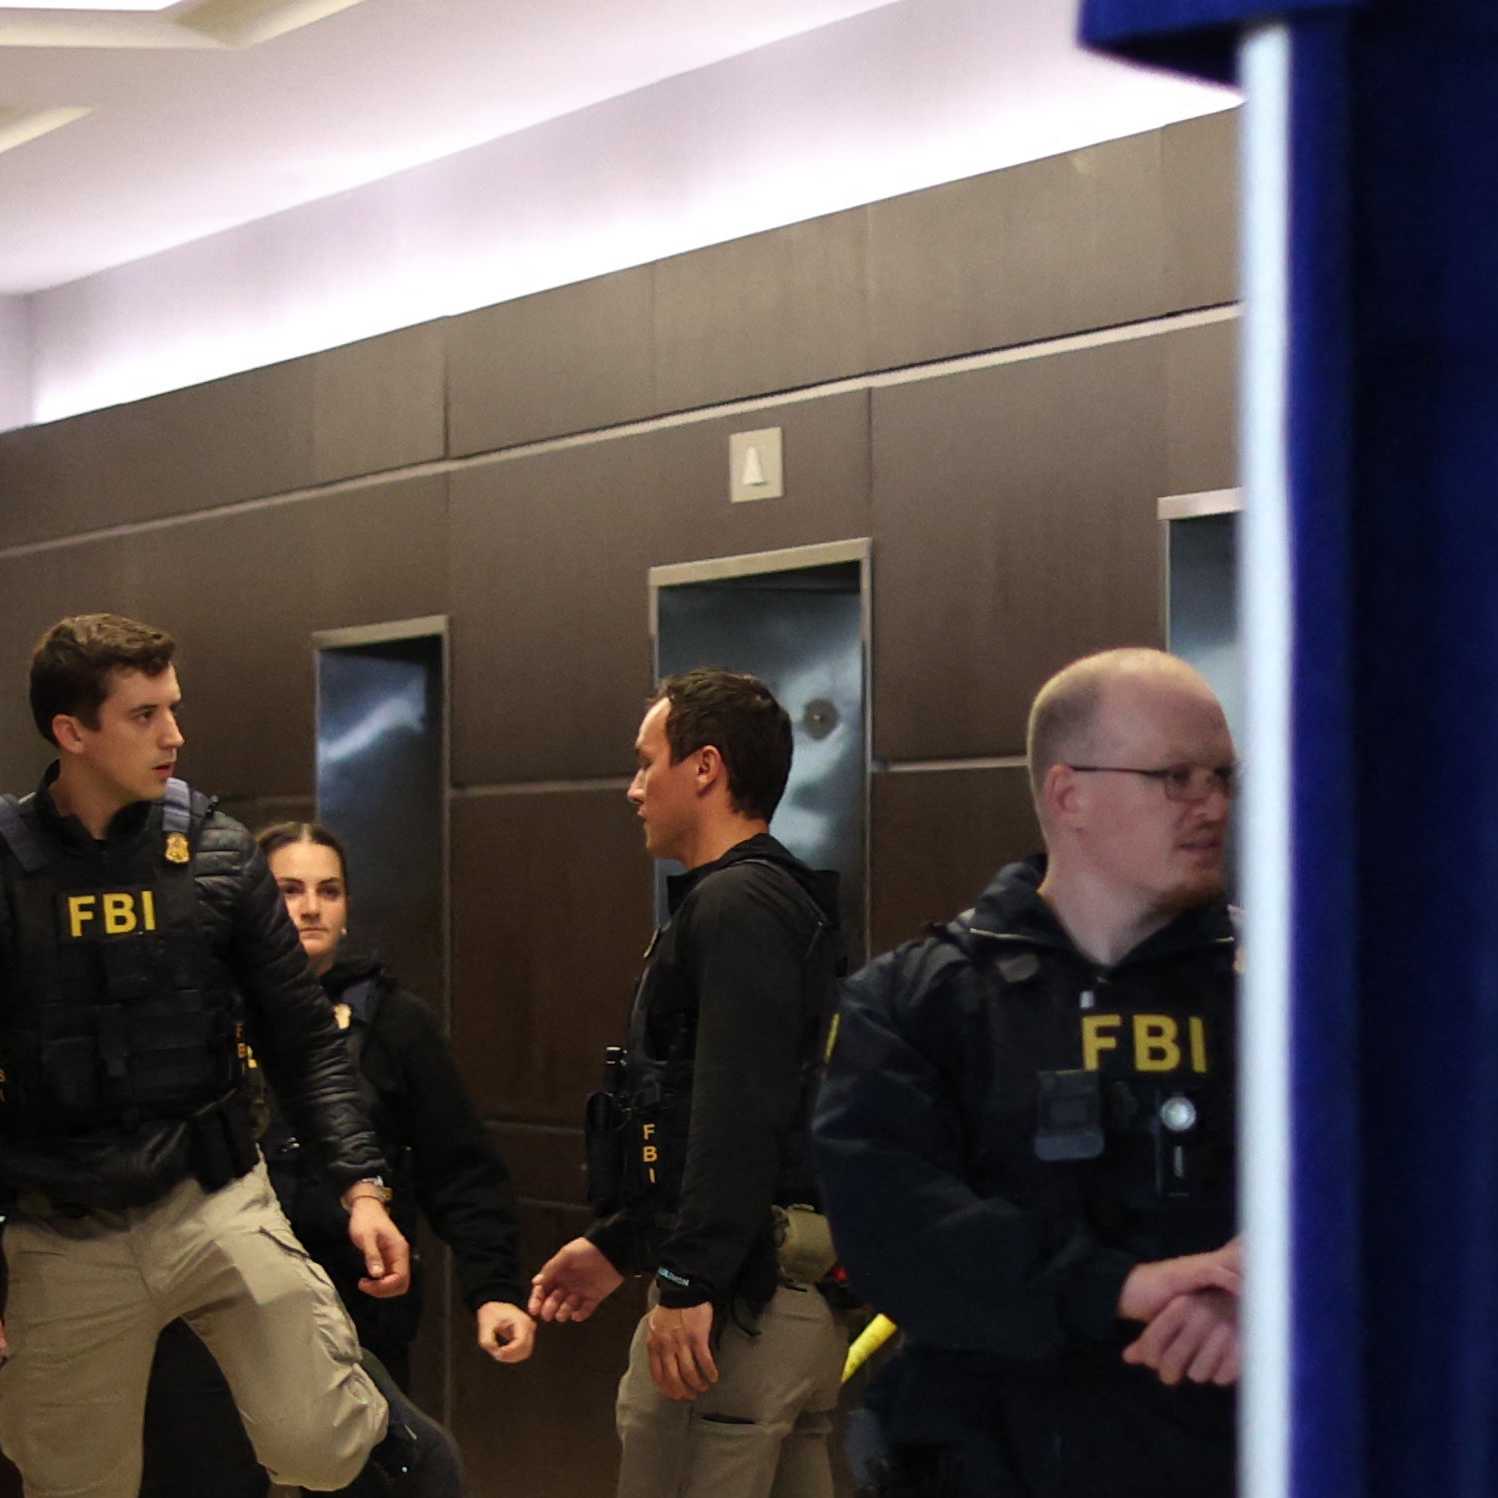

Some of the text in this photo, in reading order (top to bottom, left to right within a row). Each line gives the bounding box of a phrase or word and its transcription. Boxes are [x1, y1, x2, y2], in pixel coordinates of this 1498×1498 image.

[68, 890, 157, 938] FBI
[1082, 1013, 1207, 1072] FBI
[642, 1122, 658, 1185] FBI
